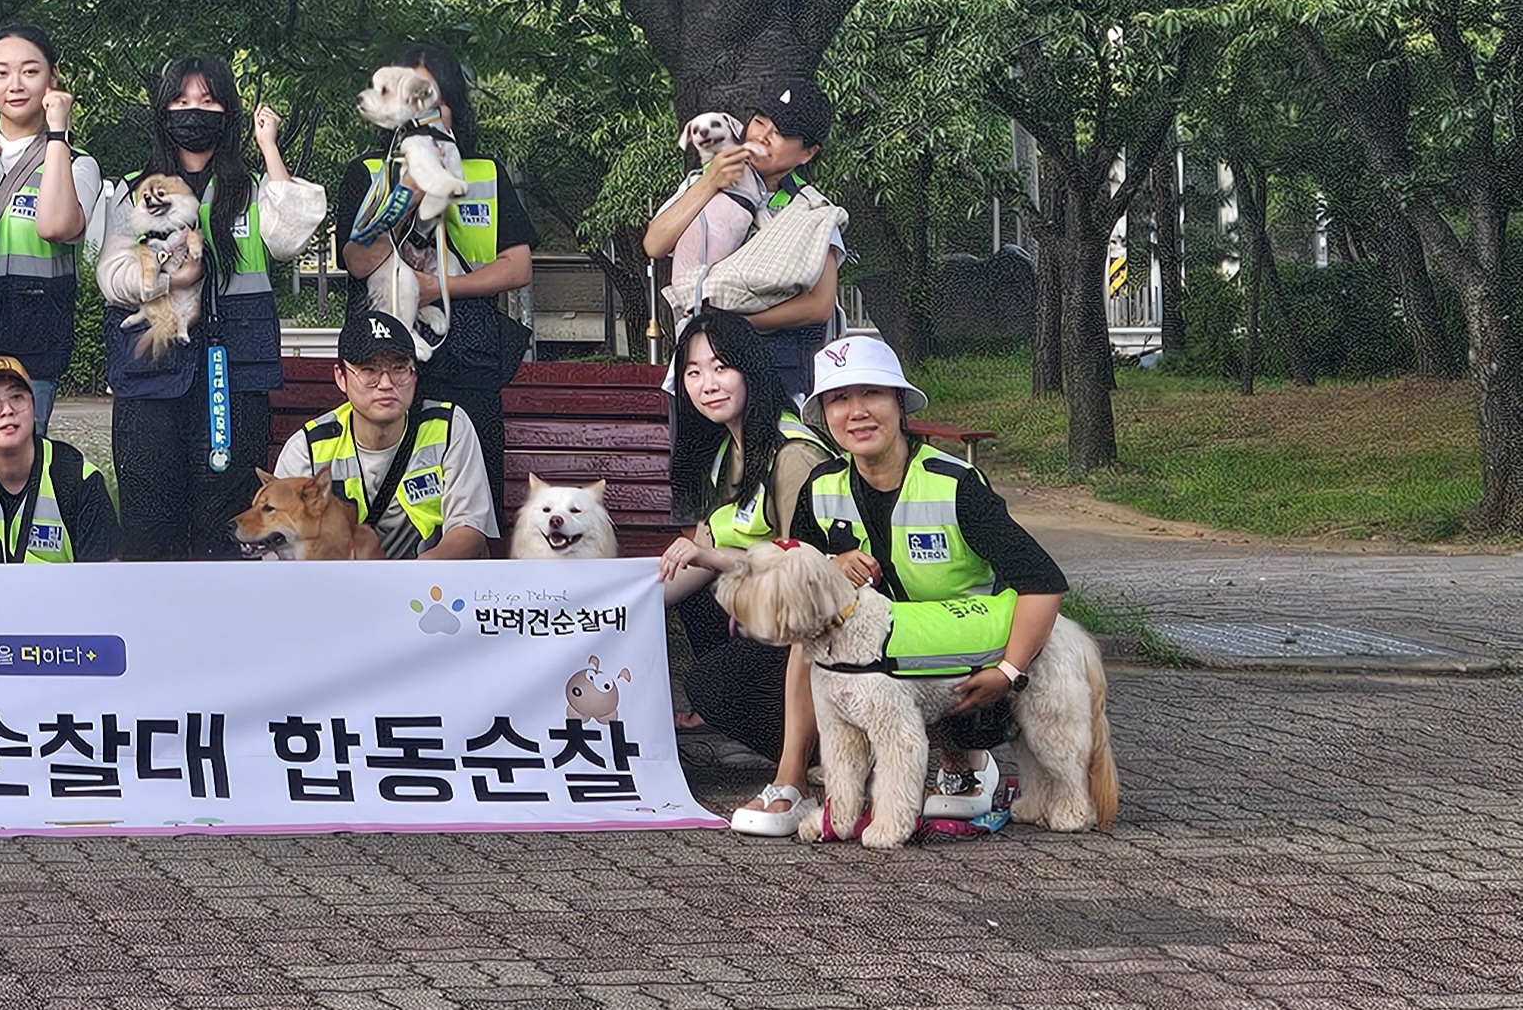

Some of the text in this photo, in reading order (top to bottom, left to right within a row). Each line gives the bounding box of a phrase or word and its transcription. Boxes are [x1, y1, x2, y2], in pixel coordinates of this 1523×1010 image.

[368, 318, 392, 339] LA
[910, 551, 948, 561] PATROL
[475, 607, 627, 637] 반려견순찰대
[268, 715, 642, 803] 합동순찰
